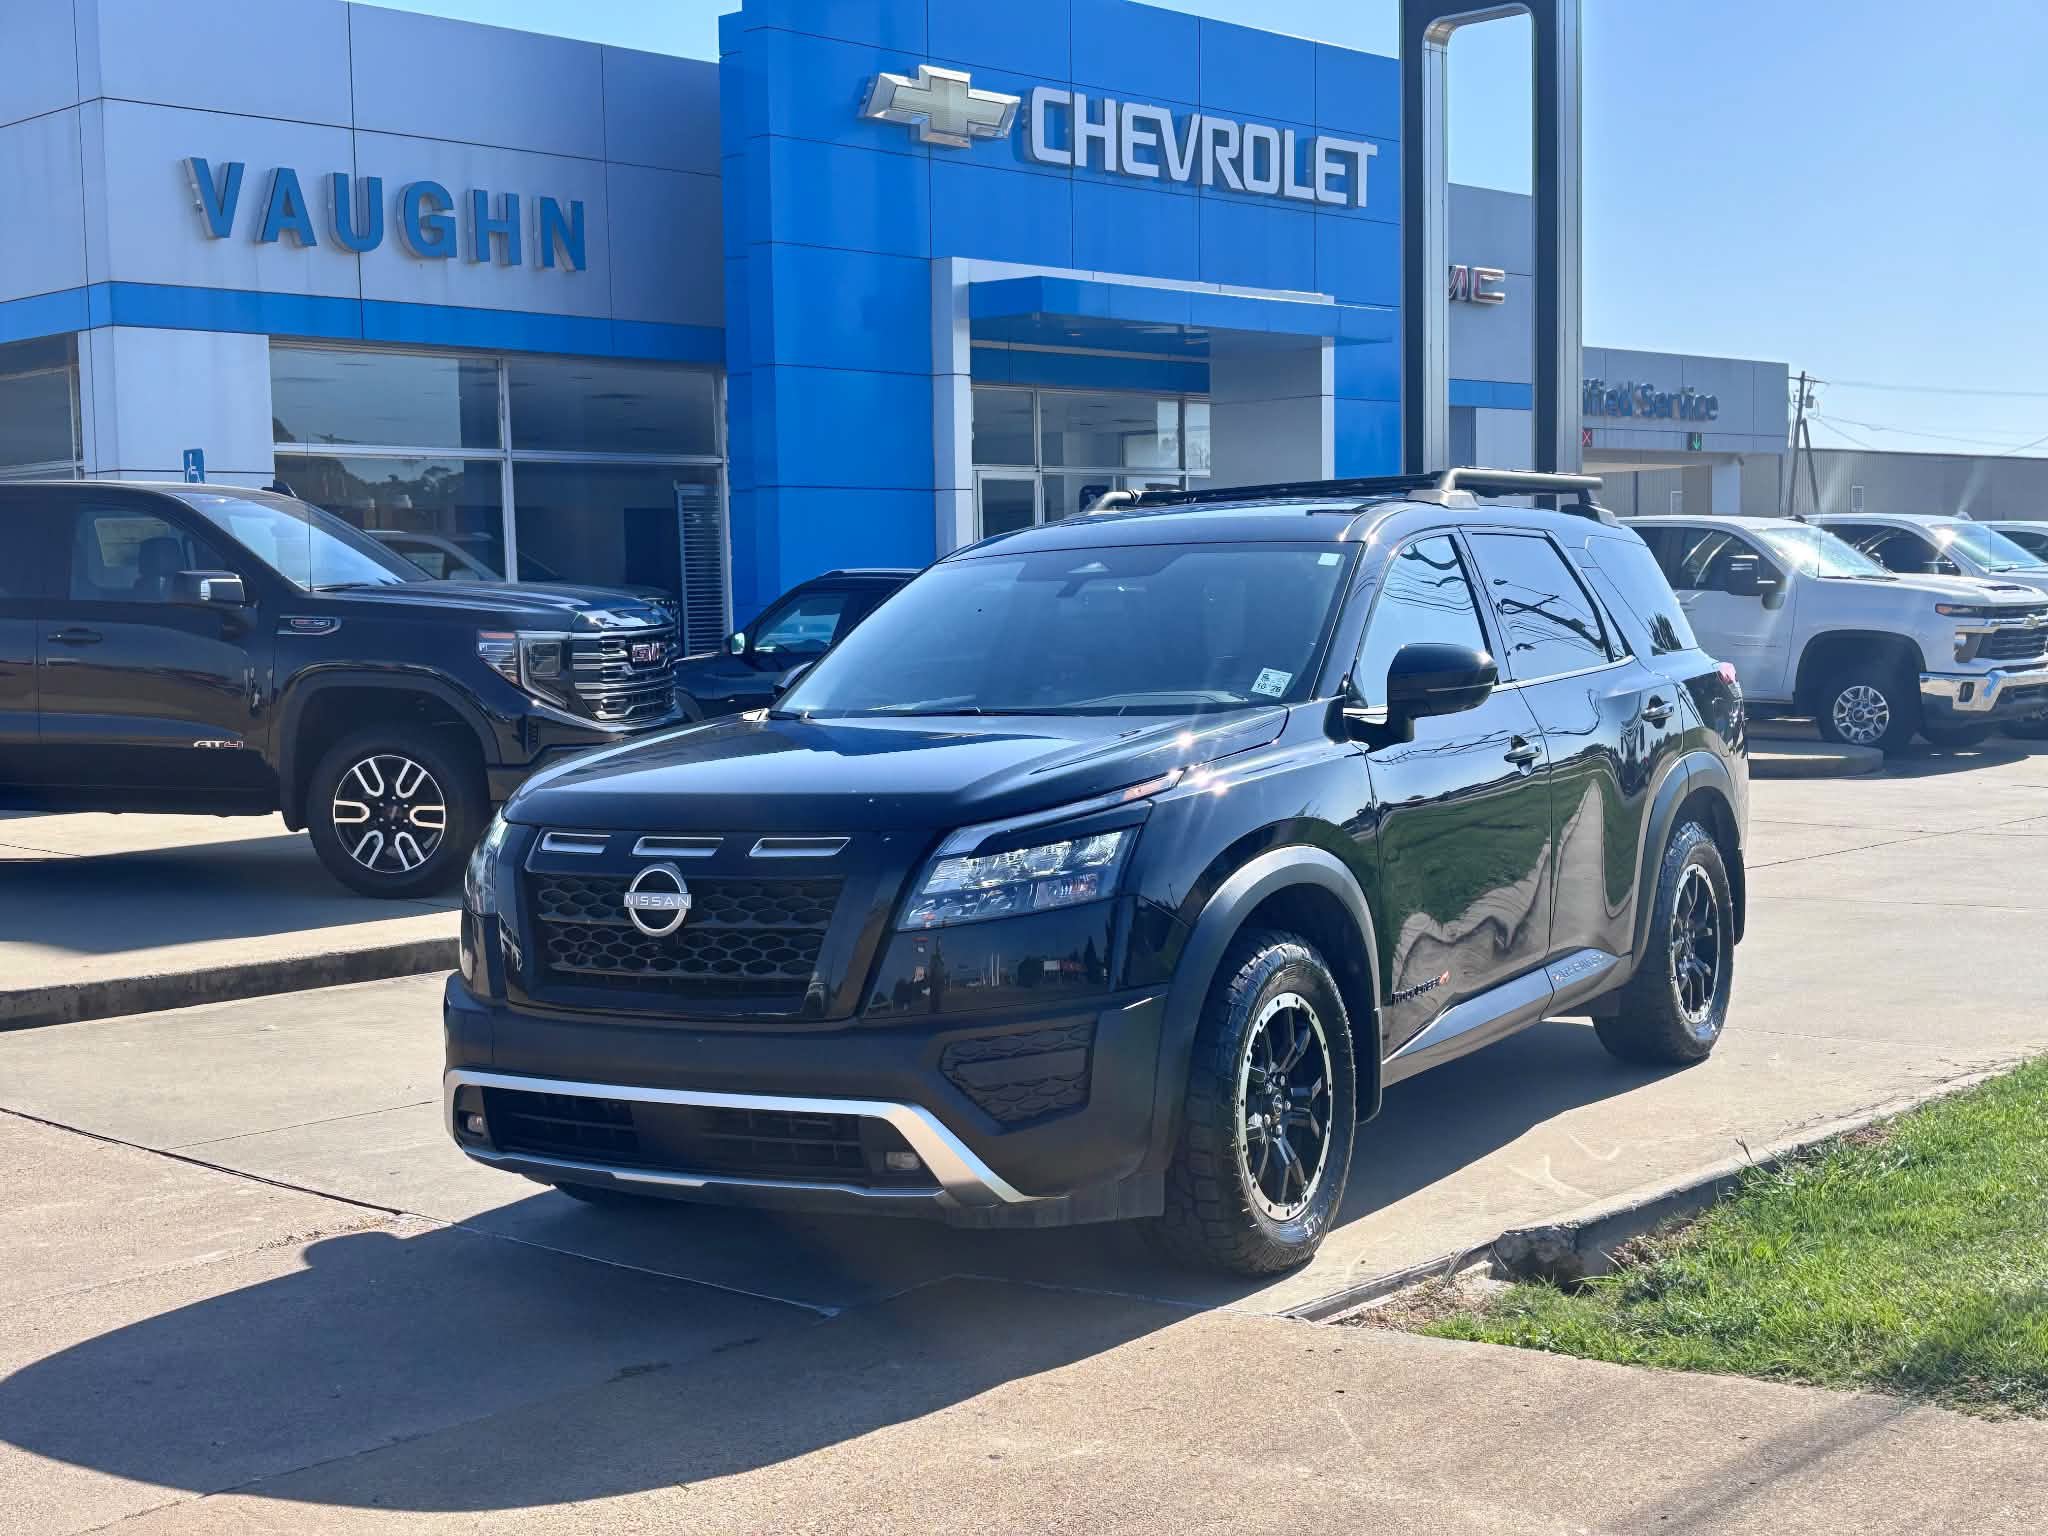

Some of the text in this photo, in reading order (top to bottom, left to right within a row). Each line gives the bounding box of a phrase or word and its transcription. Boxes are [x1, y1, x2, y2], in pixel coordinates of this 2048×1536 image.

[1030, 86, 1378, 208] CHEVROLET
[184, 157, 587, 272] VAUGHN
[1639, 383, 1719, 421] Service
[193, 740, 244, 748] AT4
[625, 894, 689, 907] NISSAN
